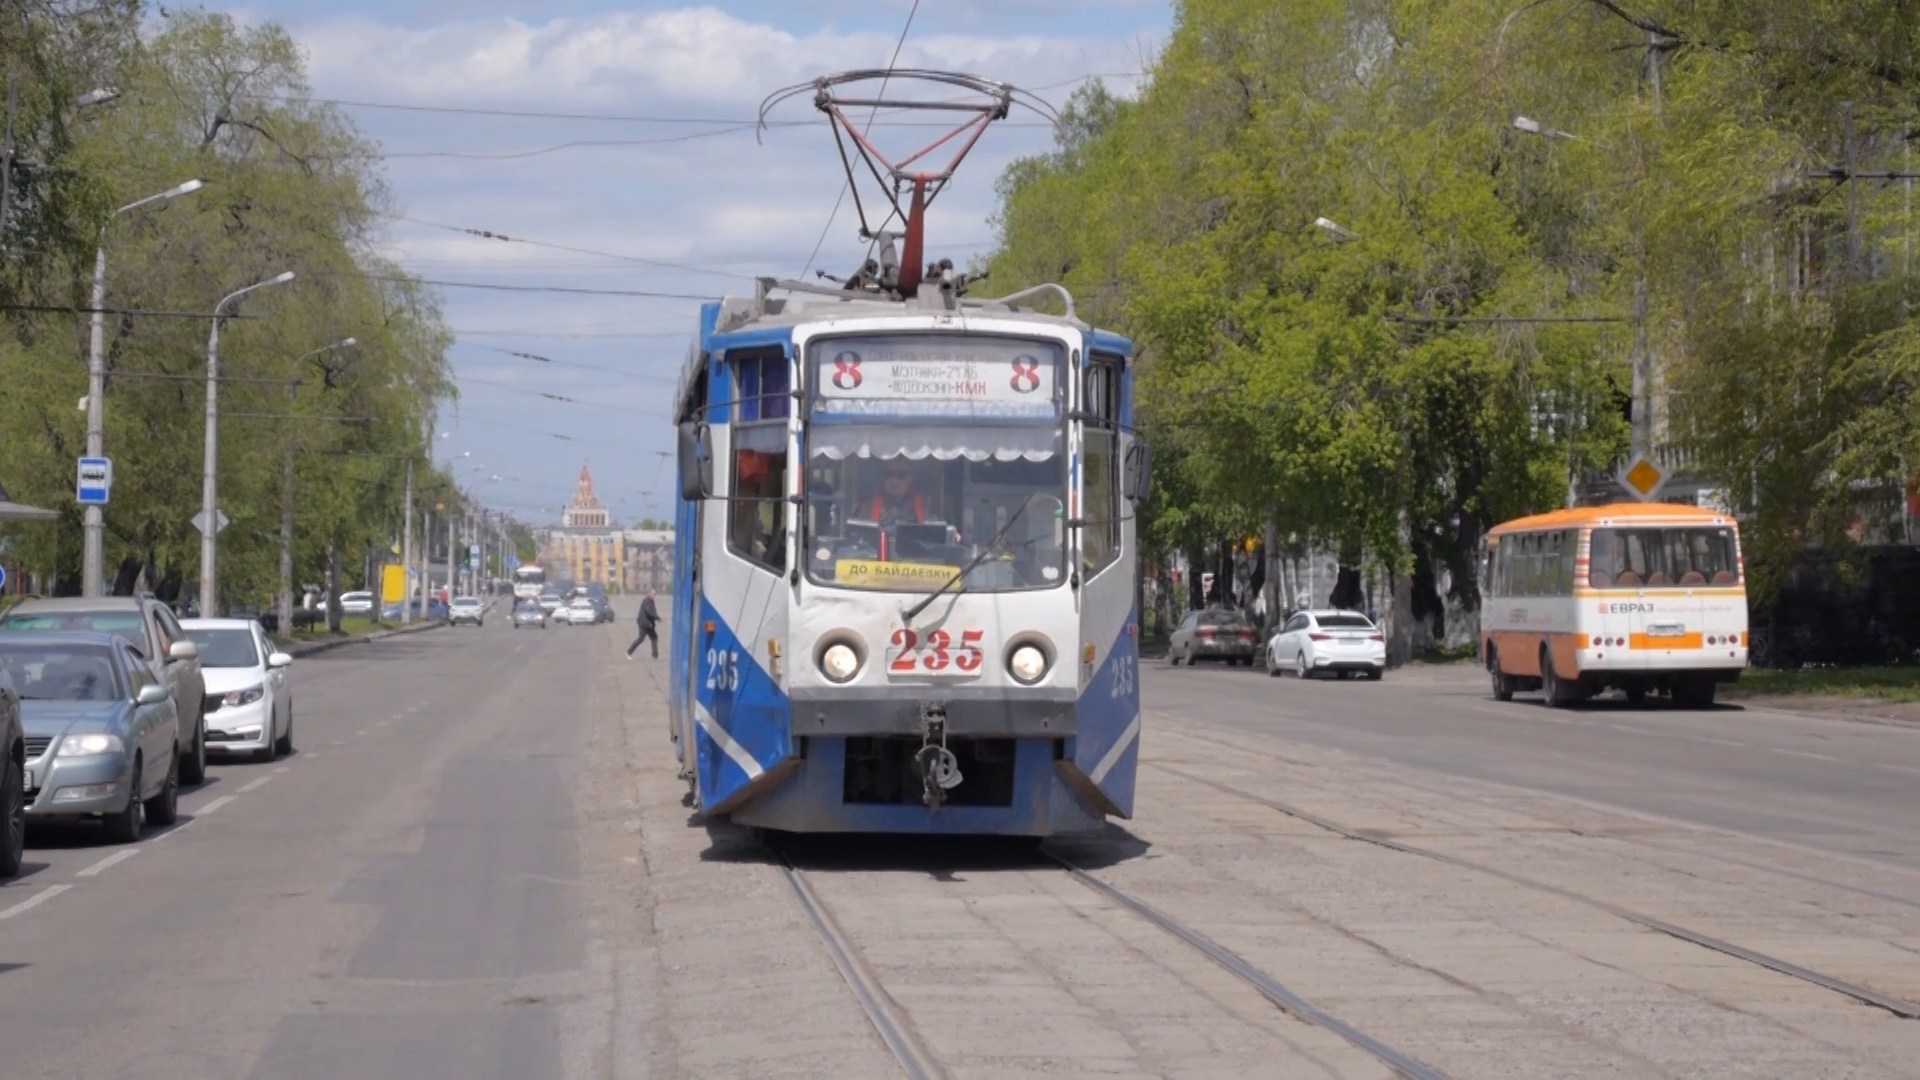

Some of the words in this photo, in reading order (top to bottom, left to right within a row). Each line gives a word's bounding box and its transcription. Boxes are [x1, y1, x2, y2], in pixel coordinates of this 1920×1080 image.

[832, 351, 862, 389] 8
[1010, 355, 1040, 393] 8
[849, 565, 868, 576] ДО
[1610, 603, 1654, 614] ЕВРАЗ
[890, 628, 984, 672] 235
[706, 648, 739, 691] 235
